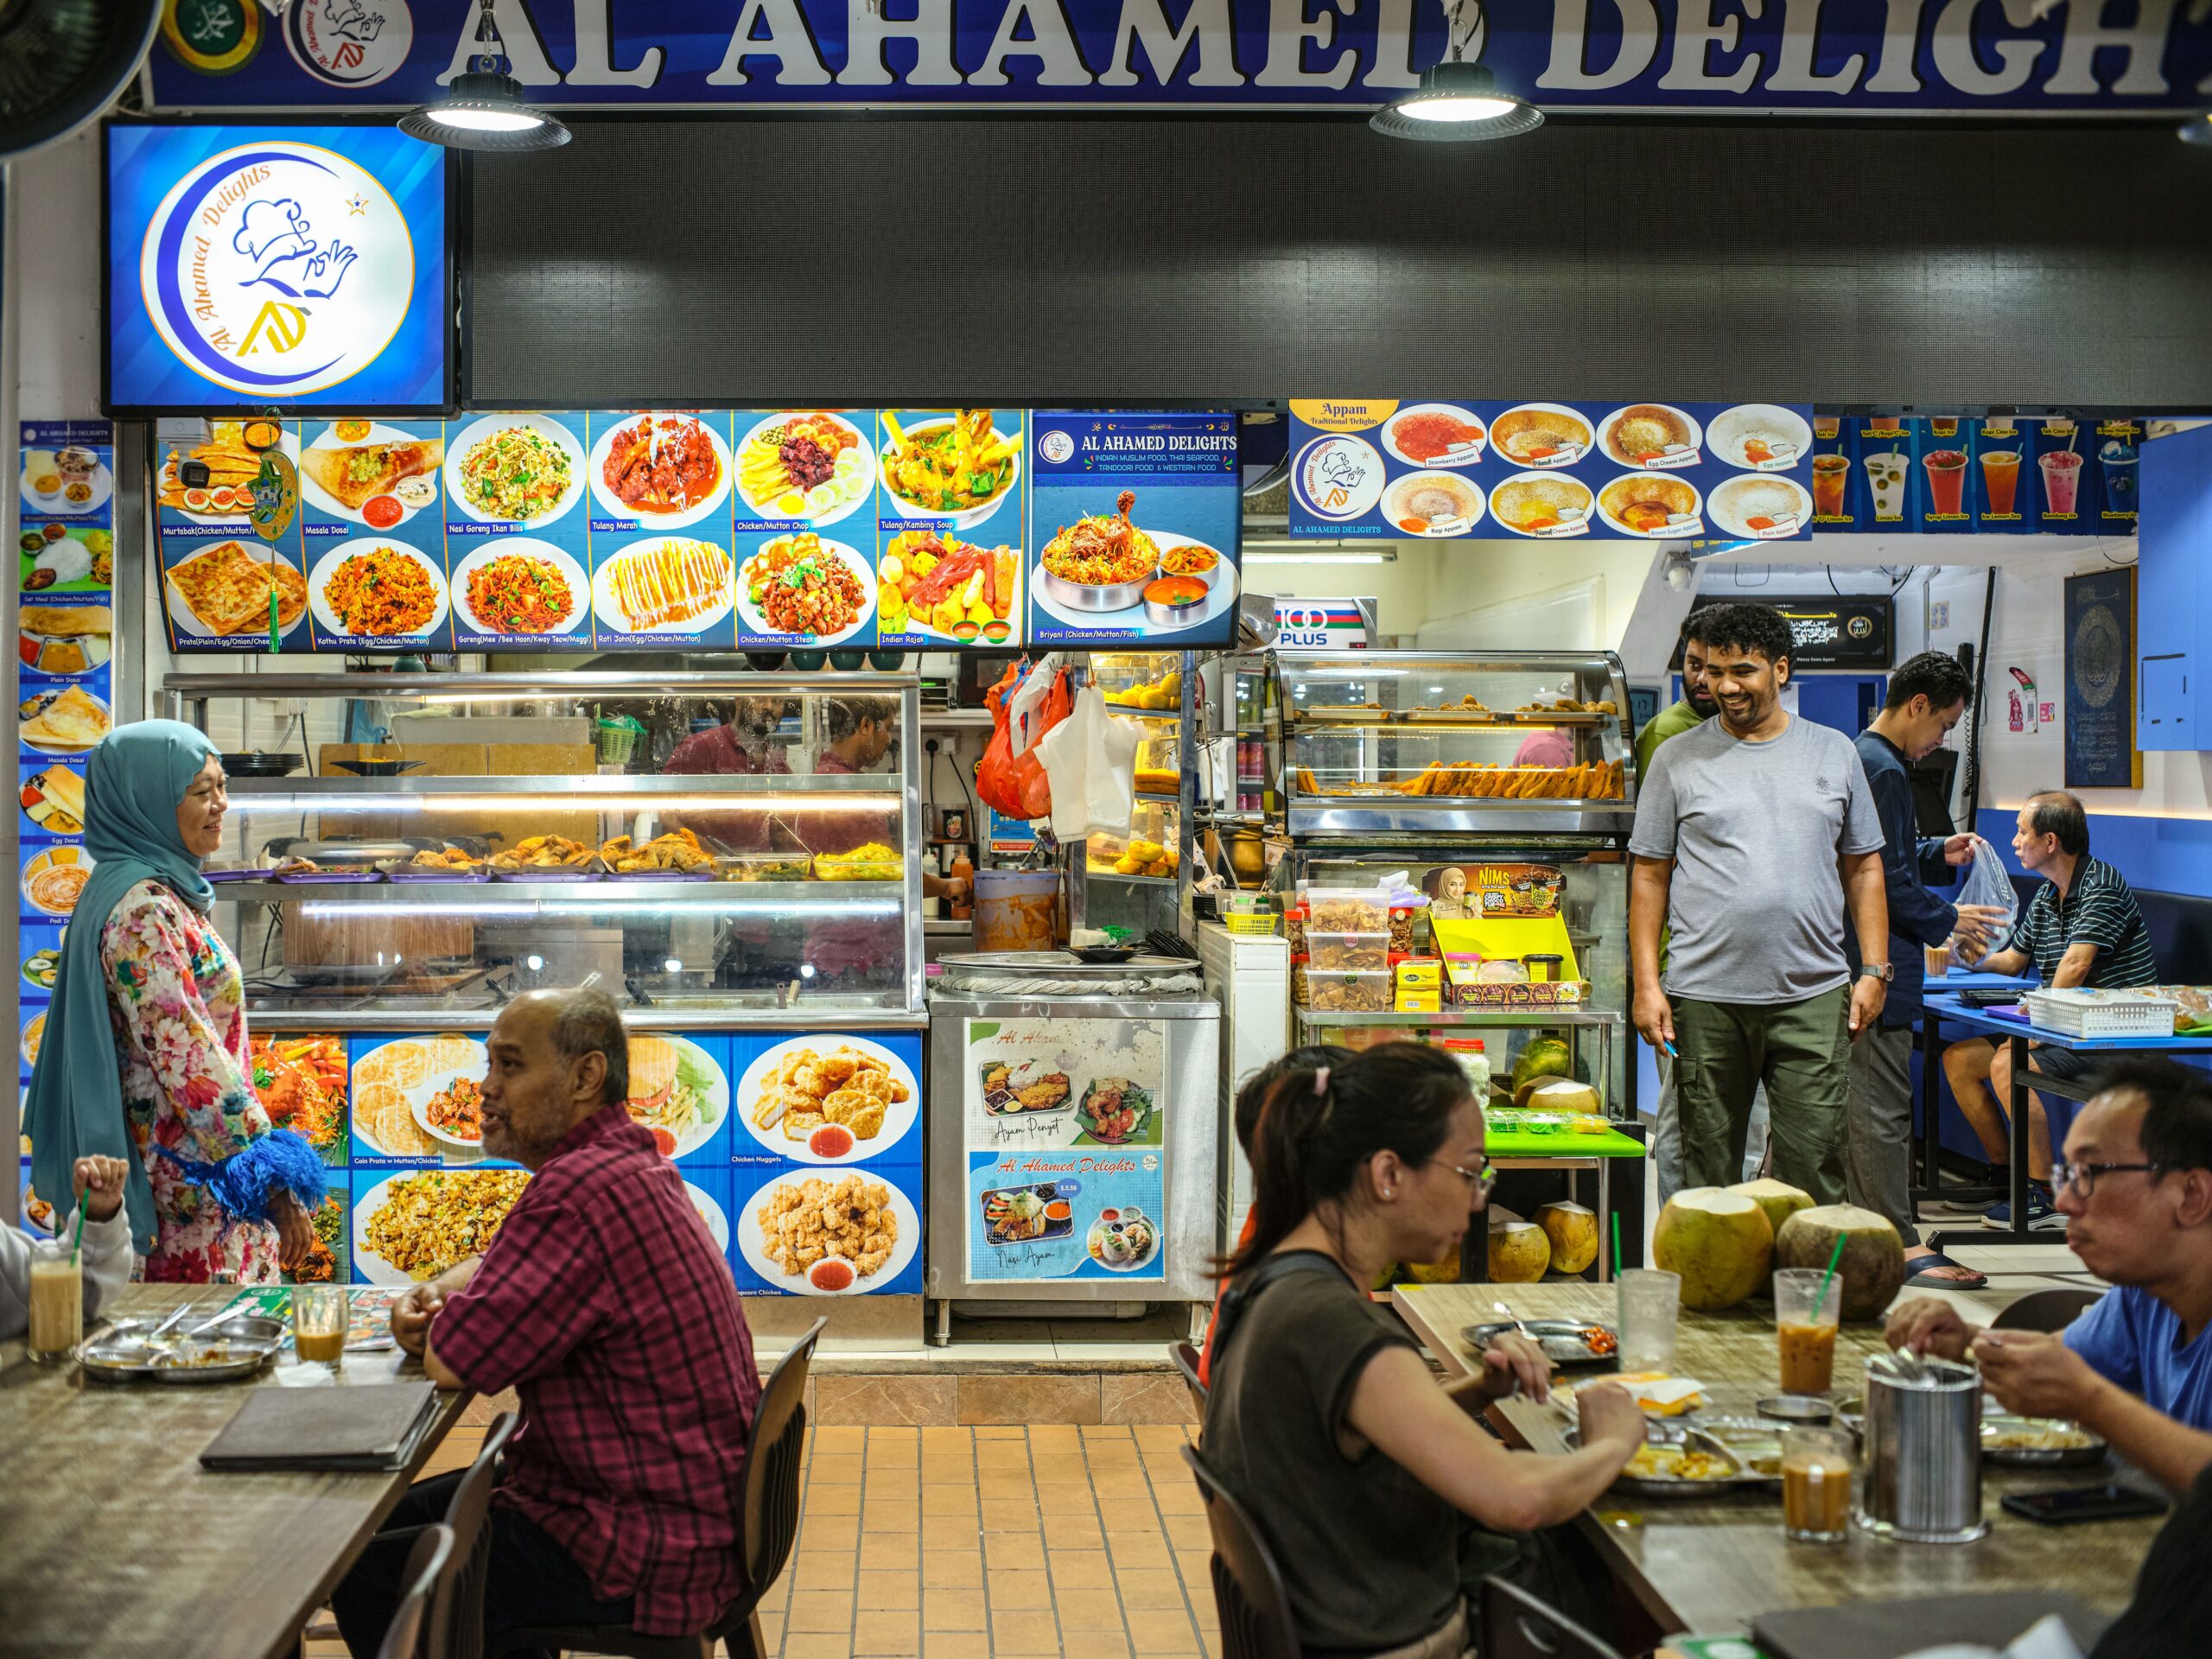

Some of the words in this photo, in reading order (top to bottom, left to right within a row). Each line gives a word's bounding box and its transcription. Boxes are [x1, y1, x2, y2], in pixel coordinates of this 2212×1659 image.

[435, 0, 663, 90] AL
[705, 0, 1488, 90] AHAMED
[1535, 0, 2212, 97] DELIGH
[202, 164, 272, 226] Delights
[192, 235, 219, 321] Ahamed
[209, 325, 238, 352] Al
[1321, 403, 1367, 417] Appam
[1349, 417, 1378, 426] Delights
[1082, 435, 1101, 451] AL
[1103, 435, 1166, 451] AHAMED
[1168, 435, 1237, 451] DELIGHTS
[1427, 457, 1456, 466] Strawberry
[1457, 453, 1475, 463] Appam
[1553, 455, 1571, 465] Appam
[1678, 454, 1697, 463] Appam
[1774, 459, 1793, 467] Appam
[1307, 465, 1316, 495] Ahamed
[1312, 440, 1337, 462] Delights
[466, 524, 490, 534] Goreng
[510, 524, 524, 532] Bilis
[593, 522, 614, 531] Tulang
[737, 521, 791, 531] Chicken/Mutton
[792, 521, 810, 531] Chop
[881, 520, 935, 531] Tulang/Kambing
[937, 521, 954, 530] Soup
[1444, 524, 1462, 533] Appam
[1569, 523, 1586, 533] Appam
[1668, 527, 1681, 536] Sugar
[1683, 522, 1700, 531] Appam
[1776, 526, 1794, 536] Appam
[1277, 606, 1328, 632] 100
[458, 635, 496, 645] Goreng(Mee
[498, 635, 514, 644] /Bee
[515, 635, 550, 645] Hoon/Kway
[552, 634, 592, 645] Teow/Maggi)
[613, 634, 702, 644] John(Egg/Chicken/Mutton)
[741, 635, 793, 645] Chicken/Mutton
[1039, 631, 1063, 639] Briyani
[1066, 630, 1140, 639] (Chicken/Mutton/Fish)
[1281, 632, 1327, 645] PLUS
[179, 638, 283, 646] Prata(Plain/Egg/Onion/Chee)
[359, 637, 430, 646] (Egg/Chicken/Mutton)
[906, 636, 925, 645] Rojak
[1478, 866, 1510, 886] NIMS
[996, 1030, 1017, 1044] Al
[995, 1121, 1026, 1143] Ayam
[1027, 1116, 1064, 1139] Penyet
[996, 1158, 1017, 1173] Al
[1020, 1158, 1077, 1173] Ahamed
[1079, 1157, 1137, 1176] Delights
[998, 1250, 1021, 1269] Nasi
[1024, 1245, 1056, 1268] Ayam
